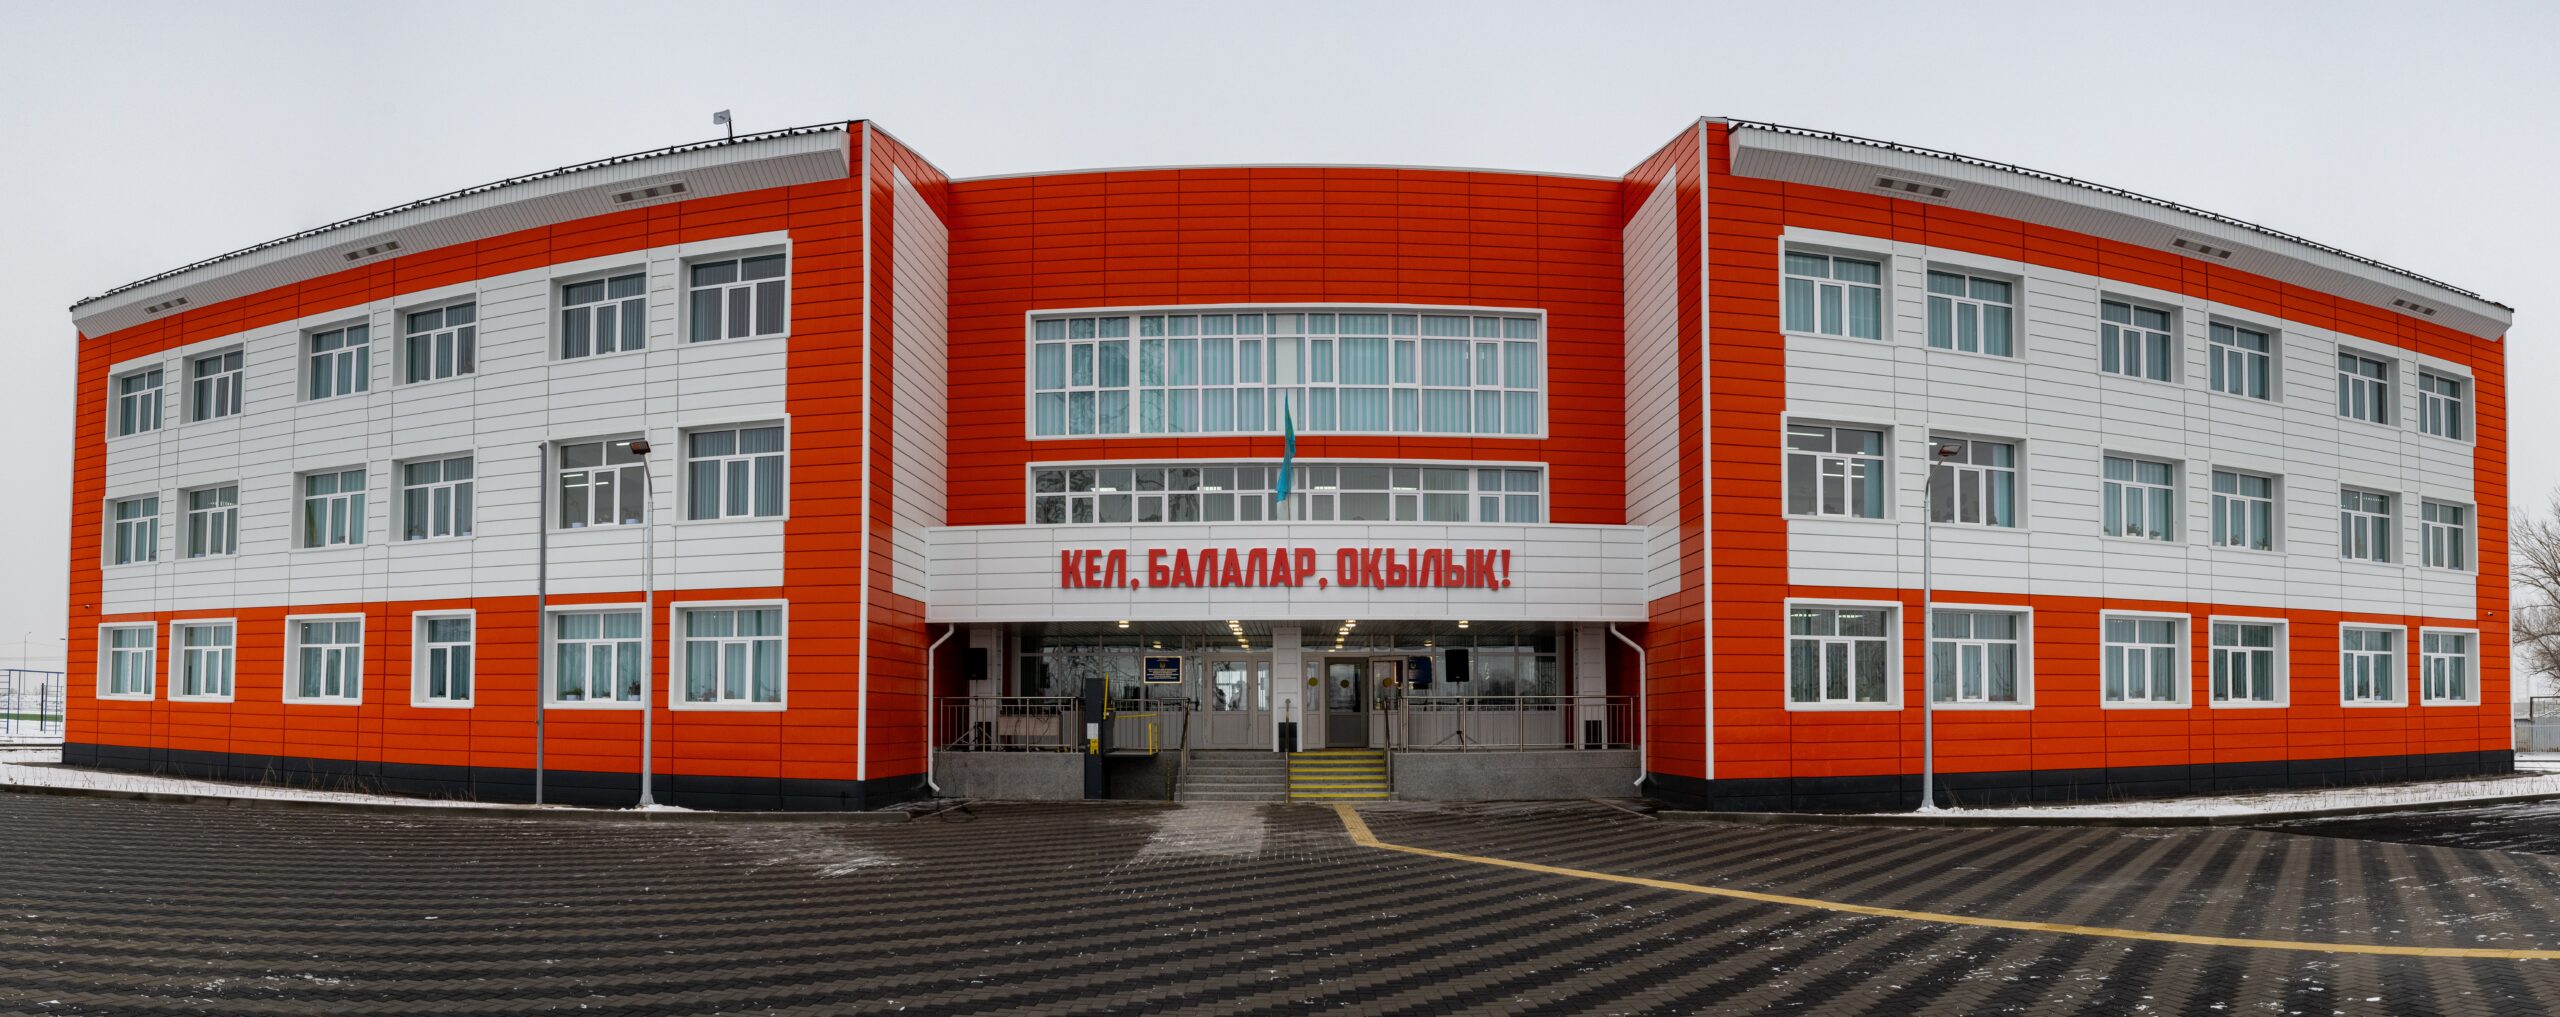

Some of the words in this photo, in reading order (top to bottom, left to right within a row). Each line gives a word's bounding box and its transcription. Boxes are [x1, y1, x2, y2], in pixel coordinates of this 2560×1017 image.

[1061, 549, 1140, 591] КЕЛ,
[1148, 547, 1328, 590] БАЛАЛАР,
[1336, 548, 1511, 591] ОҚЫЛЫҚ!
